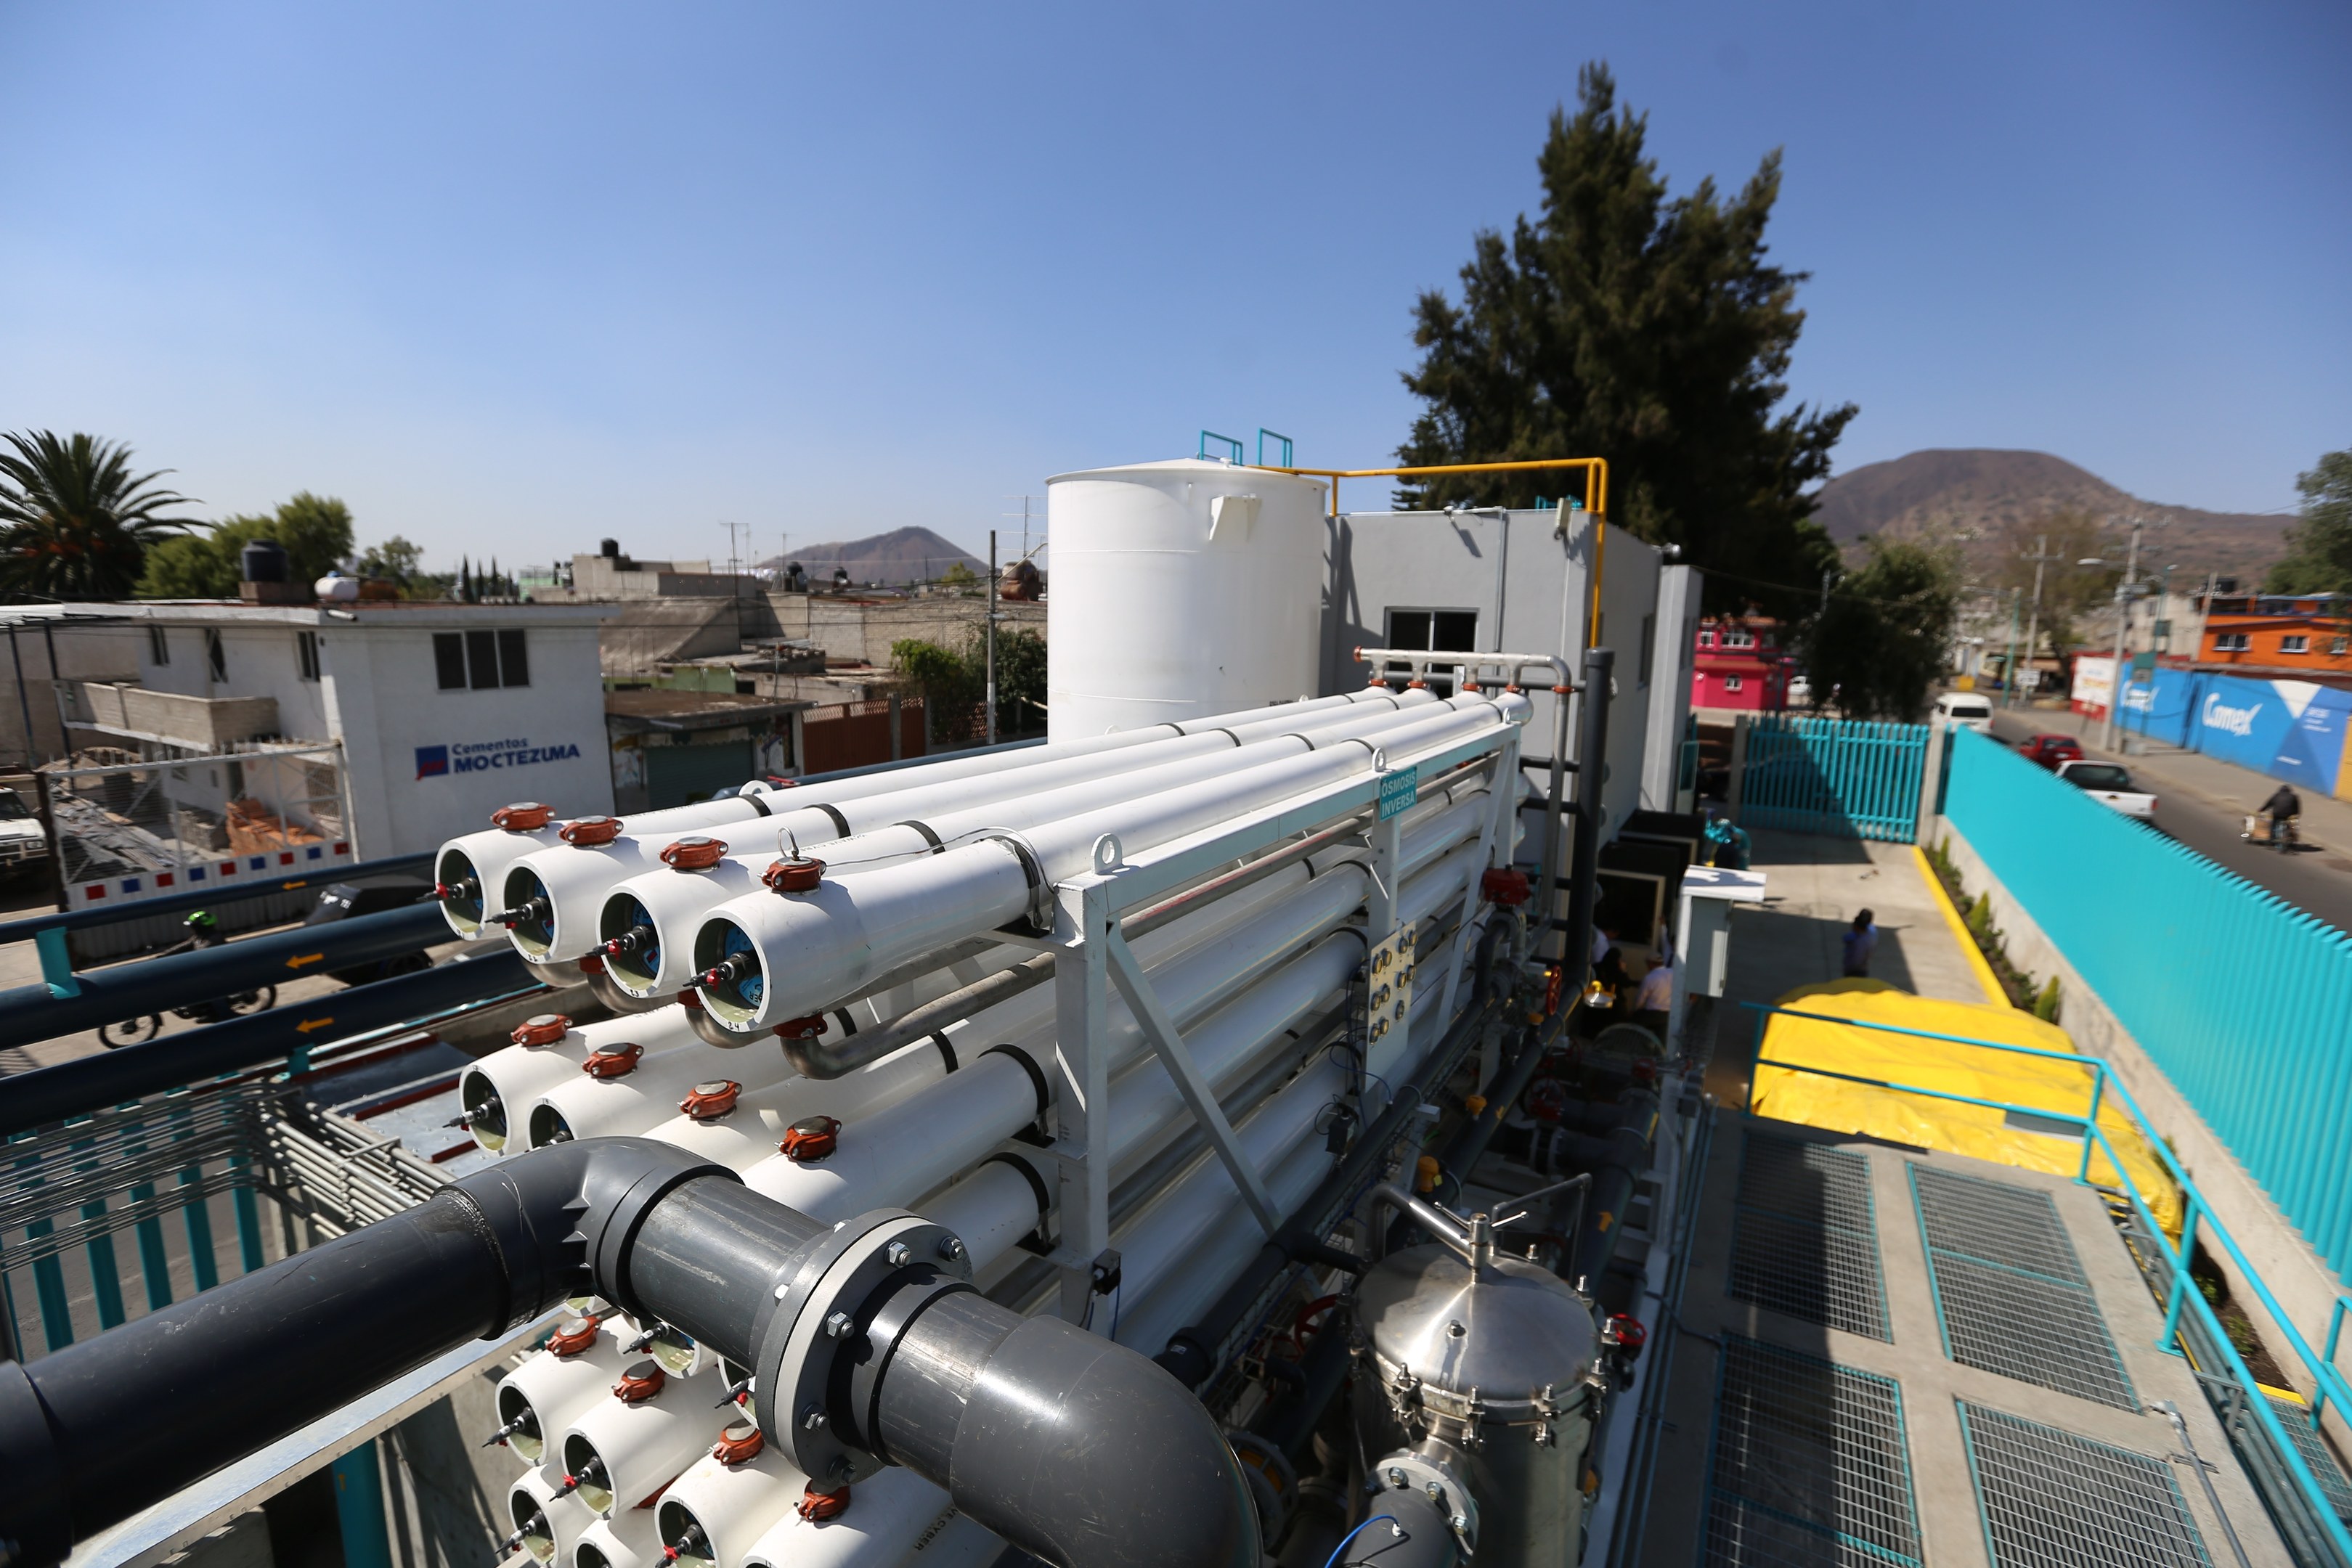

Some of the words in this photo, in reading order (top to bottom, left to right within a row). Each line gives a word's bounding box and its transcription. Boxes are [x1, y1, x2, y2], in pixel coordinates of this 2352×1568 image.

[2202, 692, 2263, 737] Comex
[452, 738, 529, 755] Cementos
[453, 743, 580, 774] MOCTEZUMA
[1382, 791, 1415, 818] INVERSA
[728, 1021, 740, 1032] 24
[914, 1520, 946, 1551] CYBER
